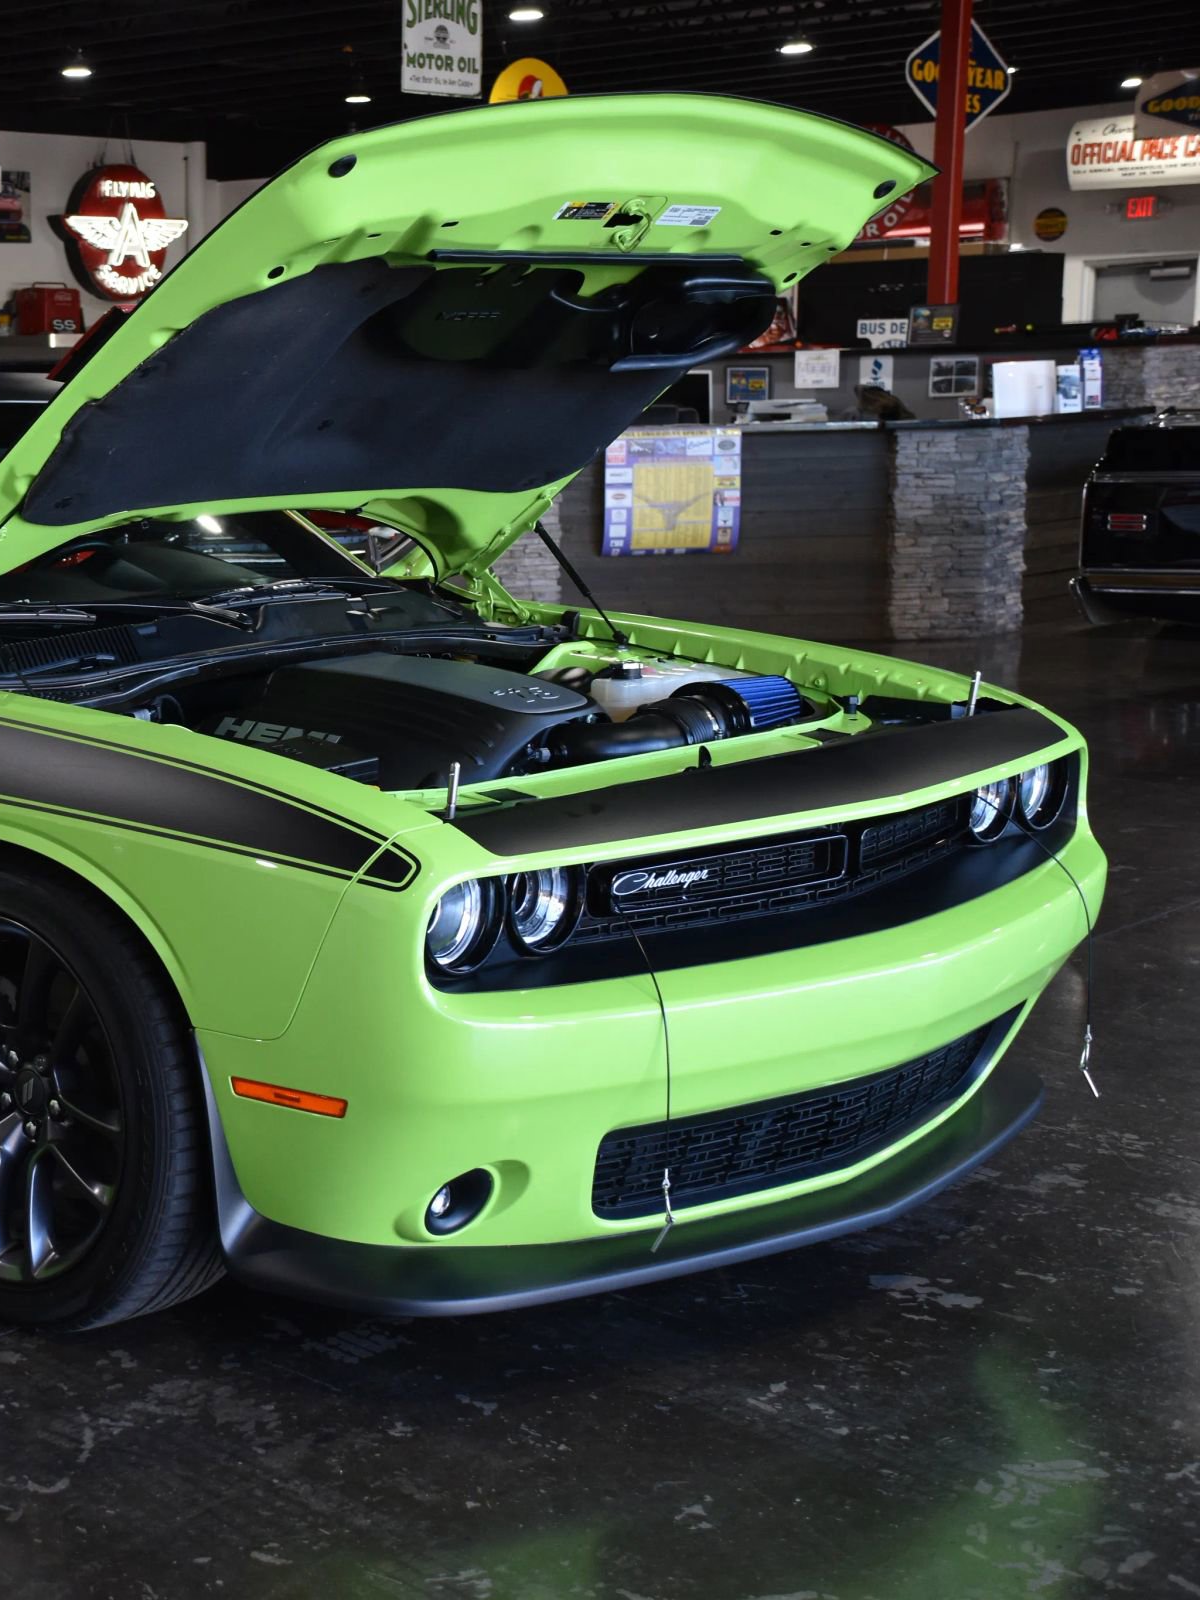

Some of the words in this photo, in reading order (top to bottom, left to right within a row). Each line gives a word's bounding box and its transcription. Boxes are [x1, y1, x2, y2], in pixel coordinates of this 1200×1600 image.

[406, 52, 454, 72] MOTOR
[457, 56, 479, 74] OIL
[912, 59, 1005, 90] GOYEAR
[1148, 95, 1200, 112] GOOD
[1071, 140, 1136, 166] OFFICIAL
[1140, 136, 1179, 161] PACE
[1184, 134, 1200, 157] CA
[102, 179, 157, 199] FLYING
[1127, 197, 1156, 219] EXIT
[52, 319, 76, 331] SS
[860, 322, 886, 335] BUS
[890, 322, 907, 334] DE
[613, 869, 709, 896] Challenger
